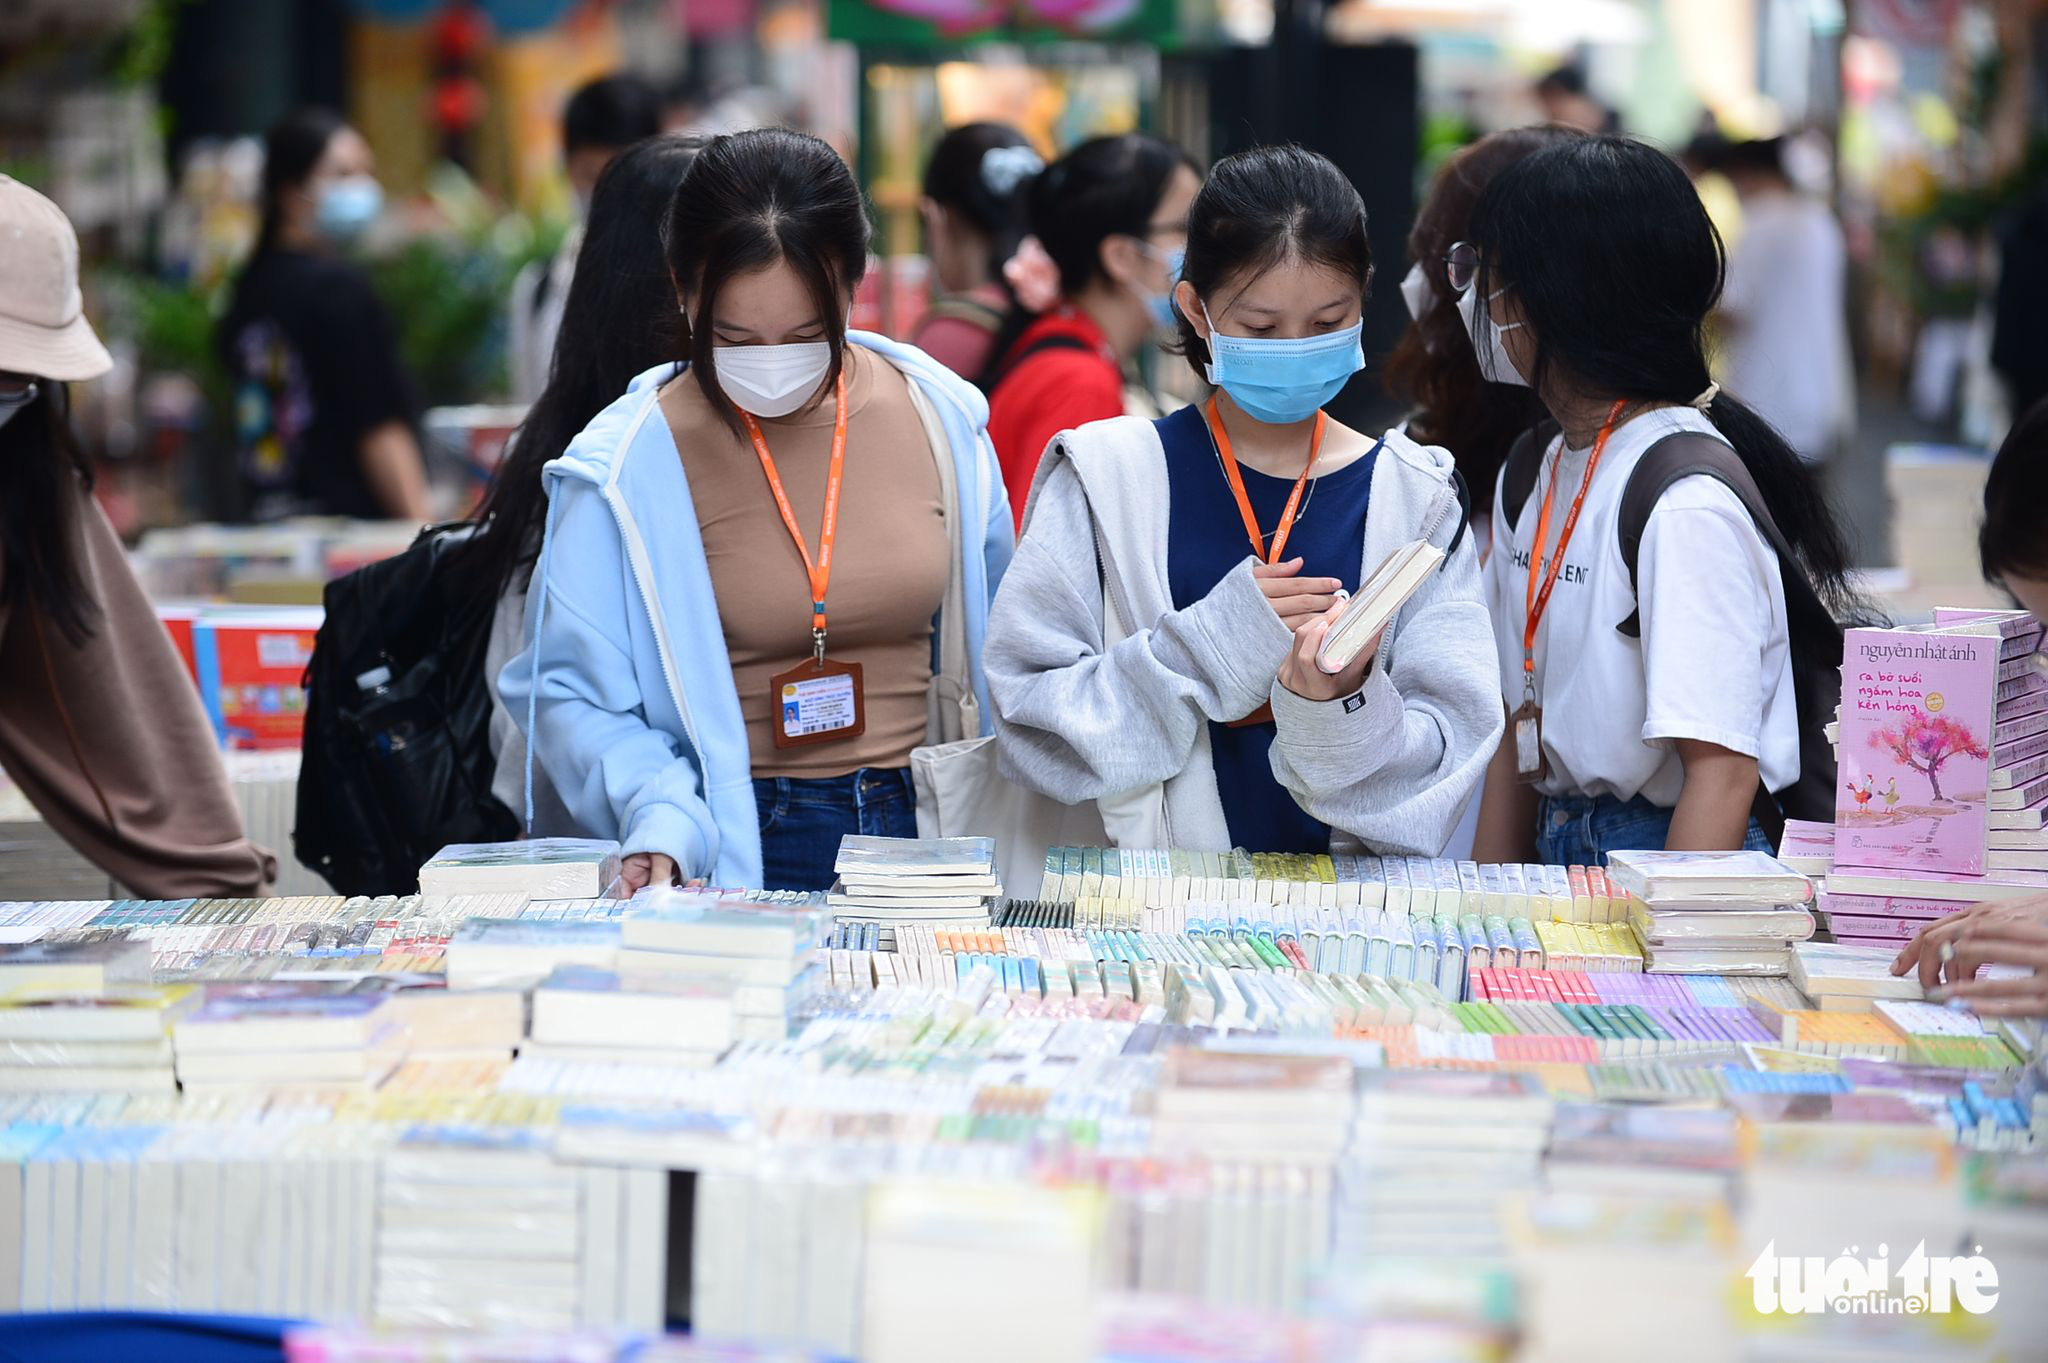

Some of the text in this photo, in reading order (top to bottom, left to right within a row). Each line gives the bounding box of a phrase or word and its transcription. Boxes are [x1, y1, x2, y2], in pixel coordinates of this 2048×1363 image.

[1860, 641, 1976, 663] nguyễn nhật ánh
[1859, 672, 1873, 681] ra
[1898, 672, 1922, 683] suối
[1898, 686, 1922, 698] hoa
